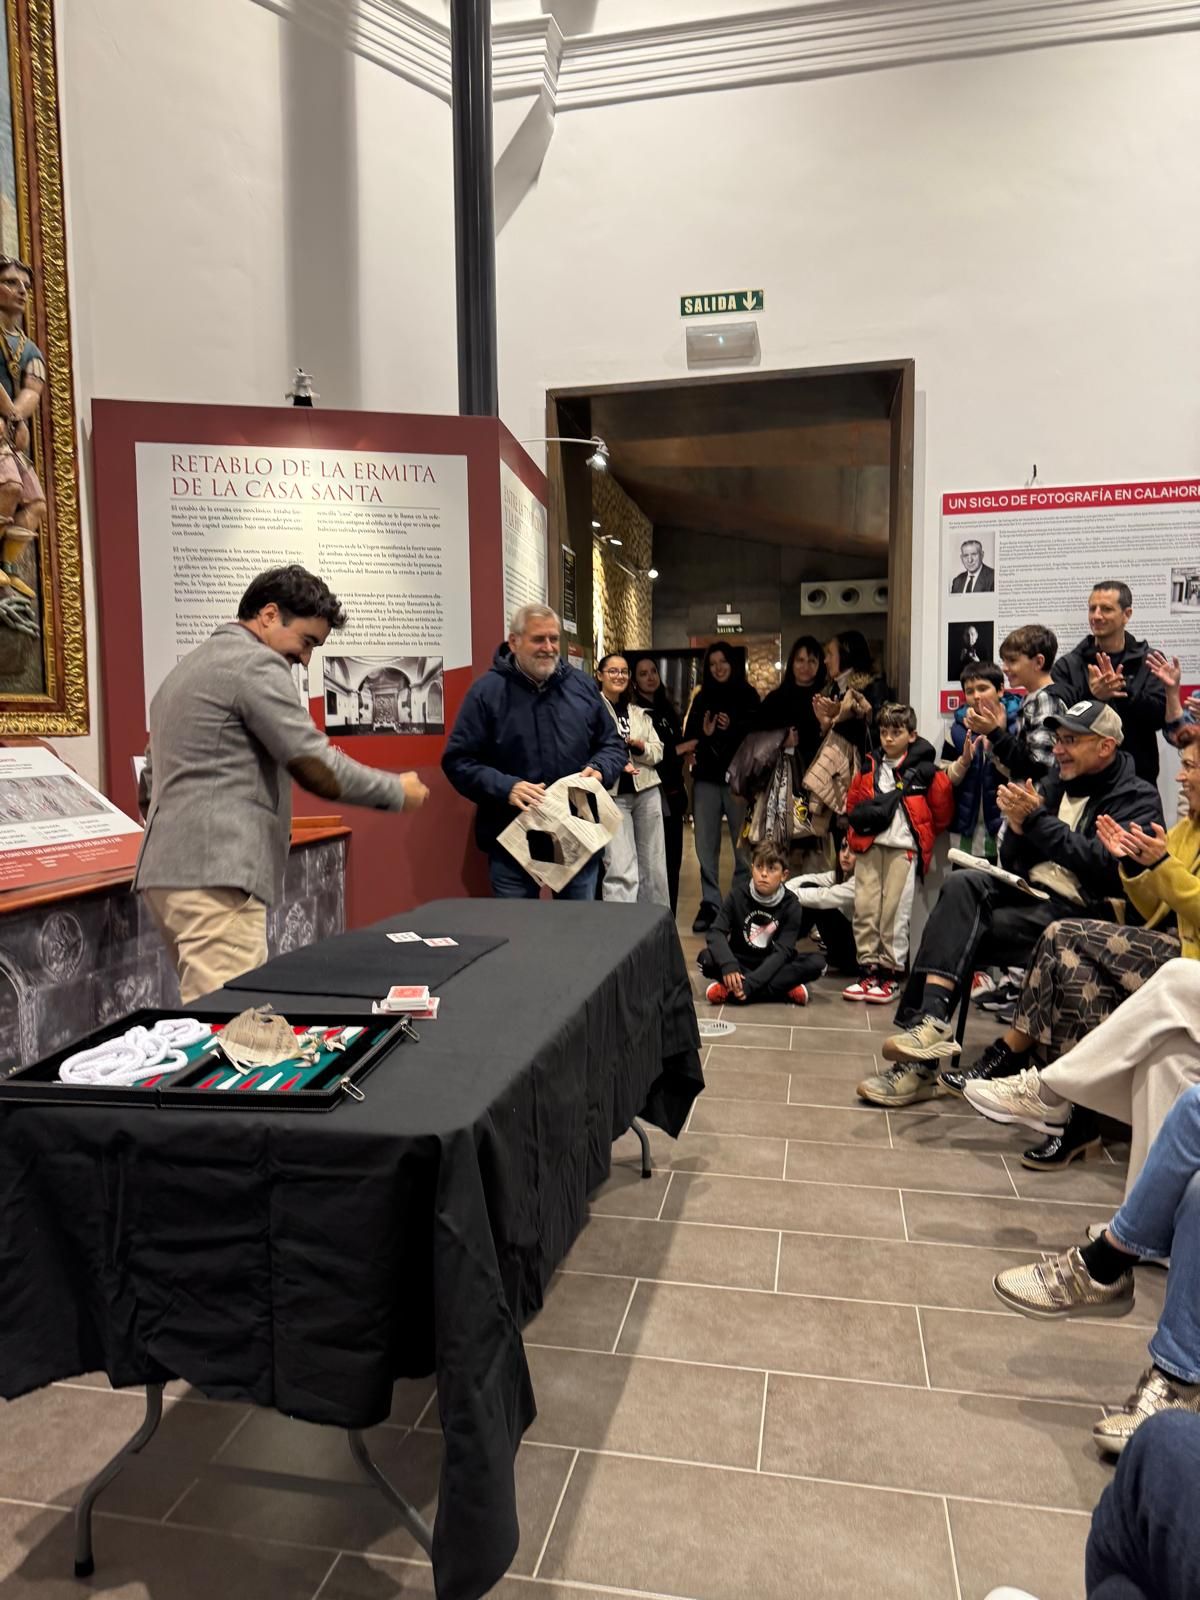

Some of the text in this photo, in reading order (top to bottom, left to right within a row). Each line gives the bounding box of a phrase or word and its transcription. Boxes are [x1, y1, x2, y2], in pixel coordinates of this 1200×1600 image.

[684, 295, 736, 314] SALIDA
[172, 454, 436, 483] RETABLO DE LA ERMITA
[172, 477, 383, 503] DE LA CASA SANTA
[949, 498, 966, 509] UN
[969, 496, 1008, 508] SIGLO
[1011, 495, 1027, 506] DE
[1030, 487, 1112, 505] FOTOGRAFÍA
[1115, 489, 1132, 500] EN
